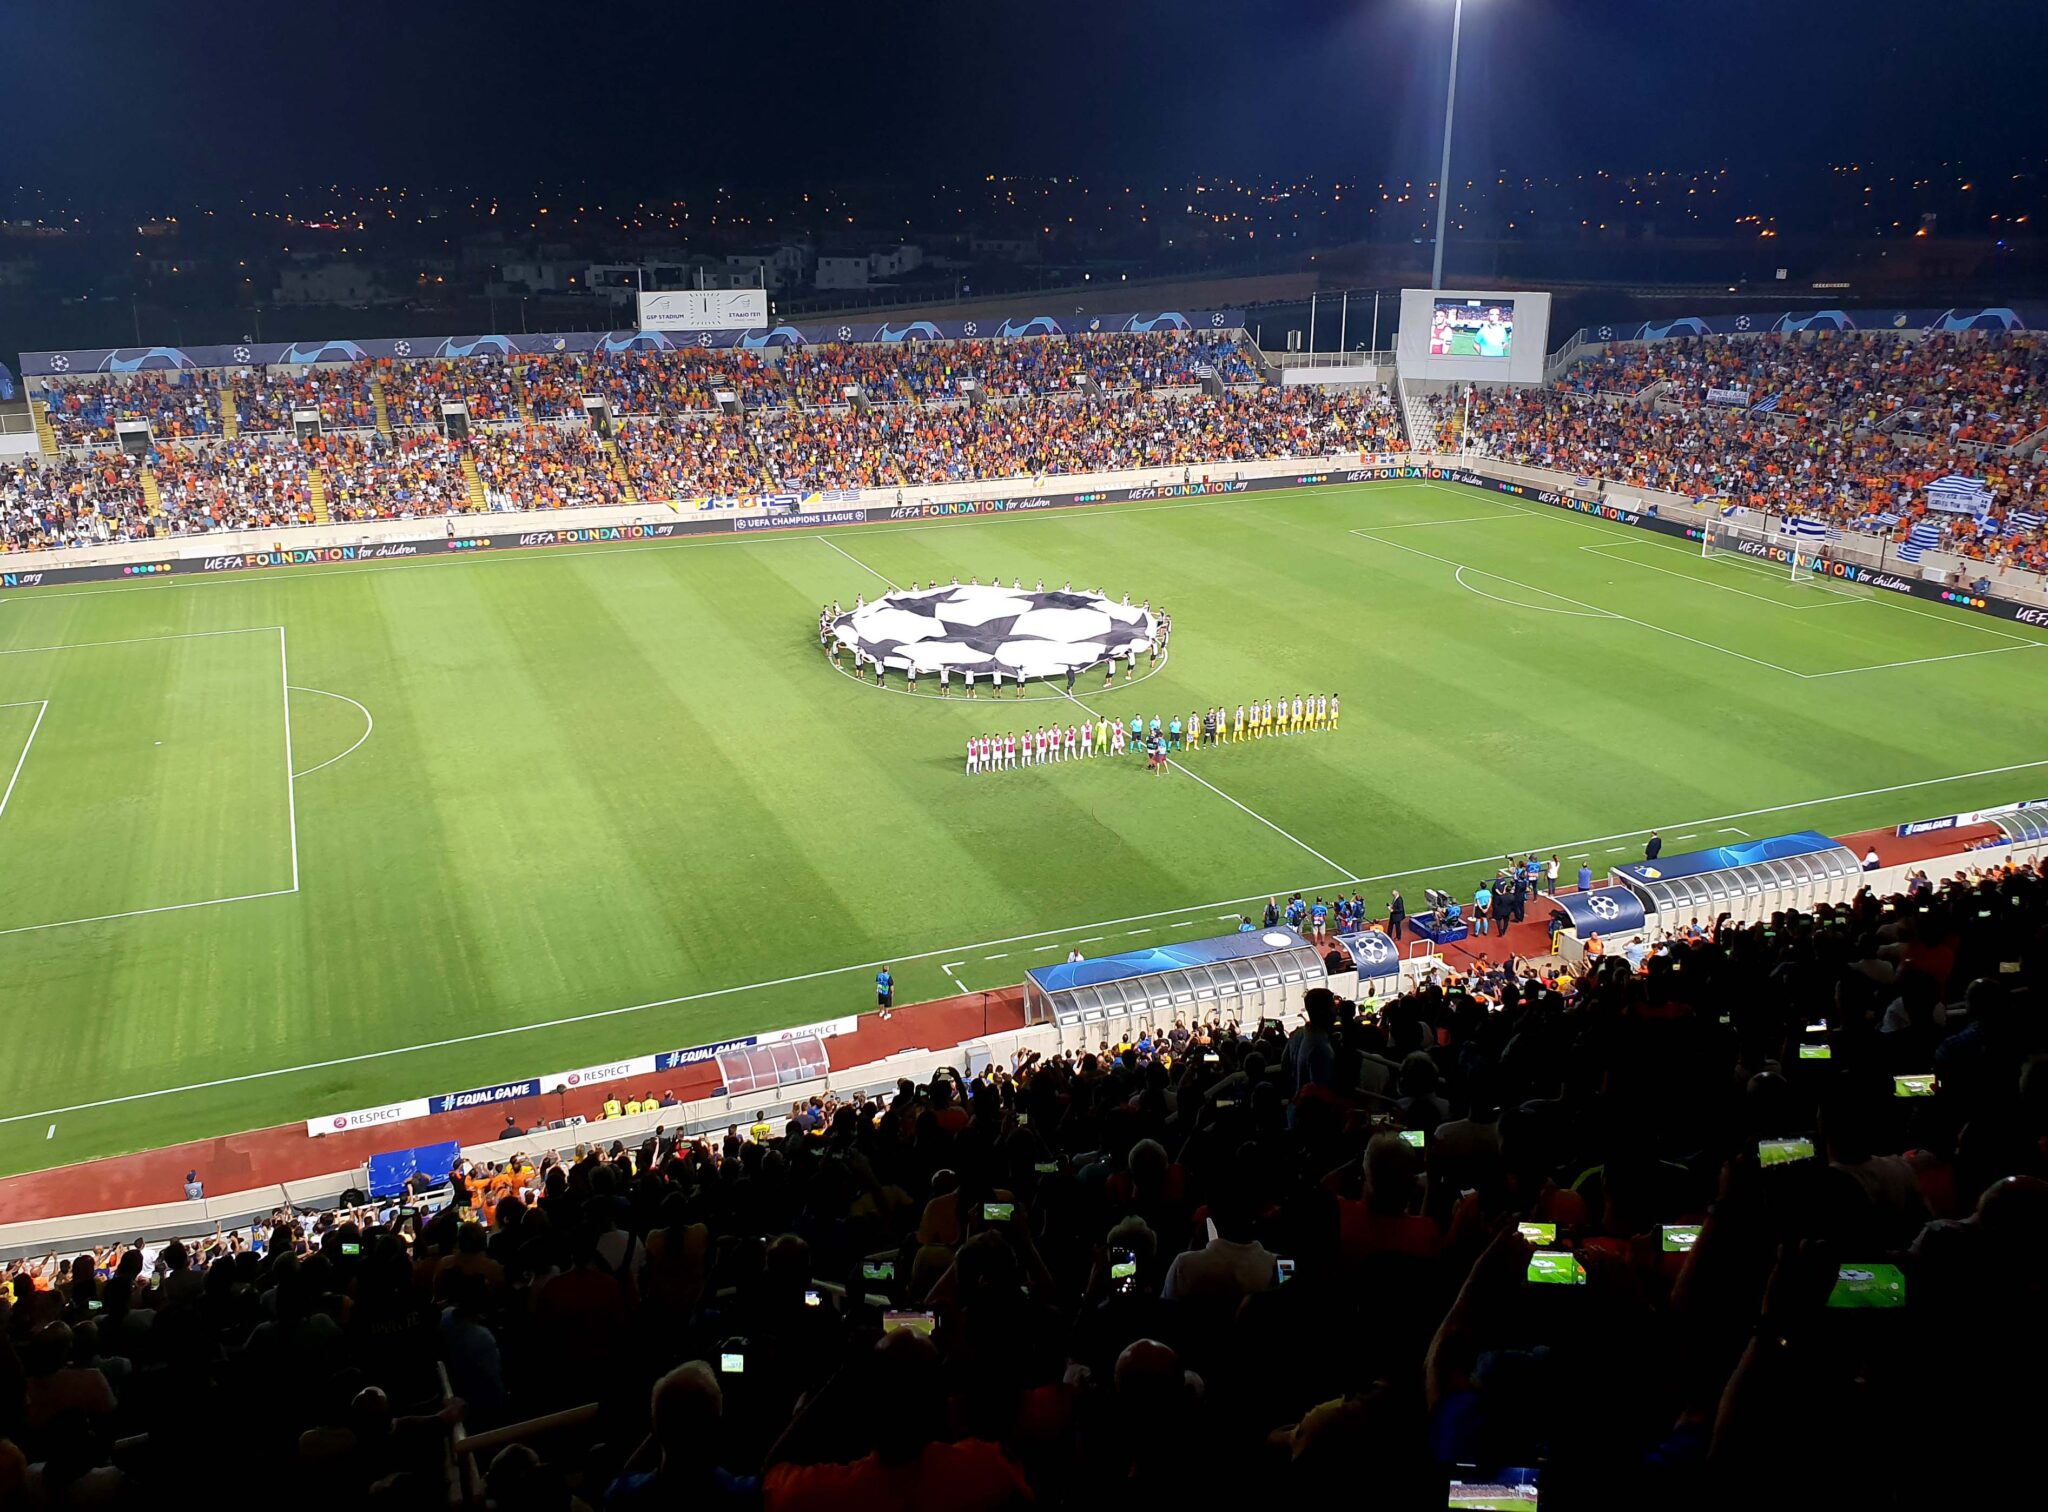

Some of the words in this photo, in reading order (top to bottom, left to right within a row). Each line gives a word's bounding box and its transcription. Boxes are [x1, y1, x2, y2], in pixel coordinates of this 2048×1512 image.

[1347, 469, 1372, 481] UEFA
[1374, 467, 1450, 480] FOUNDATION
[1451, 470, 1461, 482] for
[1461, 472, 1483, 486] children
[1128, 488, 1156, 500] UEFA
[1538, 491, 1560, 505] UEFA
[890, 507, 920, 519] UEFA
[922, 500, 1004, 516] FOUNDATION
[1006, 499, 1018, 511] for
[1020, 498, 1050, 509] children
[748, 518, 770, 527] UEFA
[771, 514, 820, 526] CHAMPIONS
[823, 512, 853, 522] LEAGUE
[520, 532, 555, 545] UEFA
[204, 555, 243, 570] UEFA
[245, 547, 355, 568] FOUNDATION
[358, 546, 373, 560] for
[376, 544, 417, 557] children
[1738, 540, 1767, 556] UEFA
[1768, 547, 1855, 579] FOUNDATON
[1856, 569, 1871, 583] for
[1872, 573, 1911, 593] children
[2015, 607, 2048, 626] UEF
[584, 1064, 630, 1081] RESPECT
[351, 1107, 401, 1125] RESPECT
